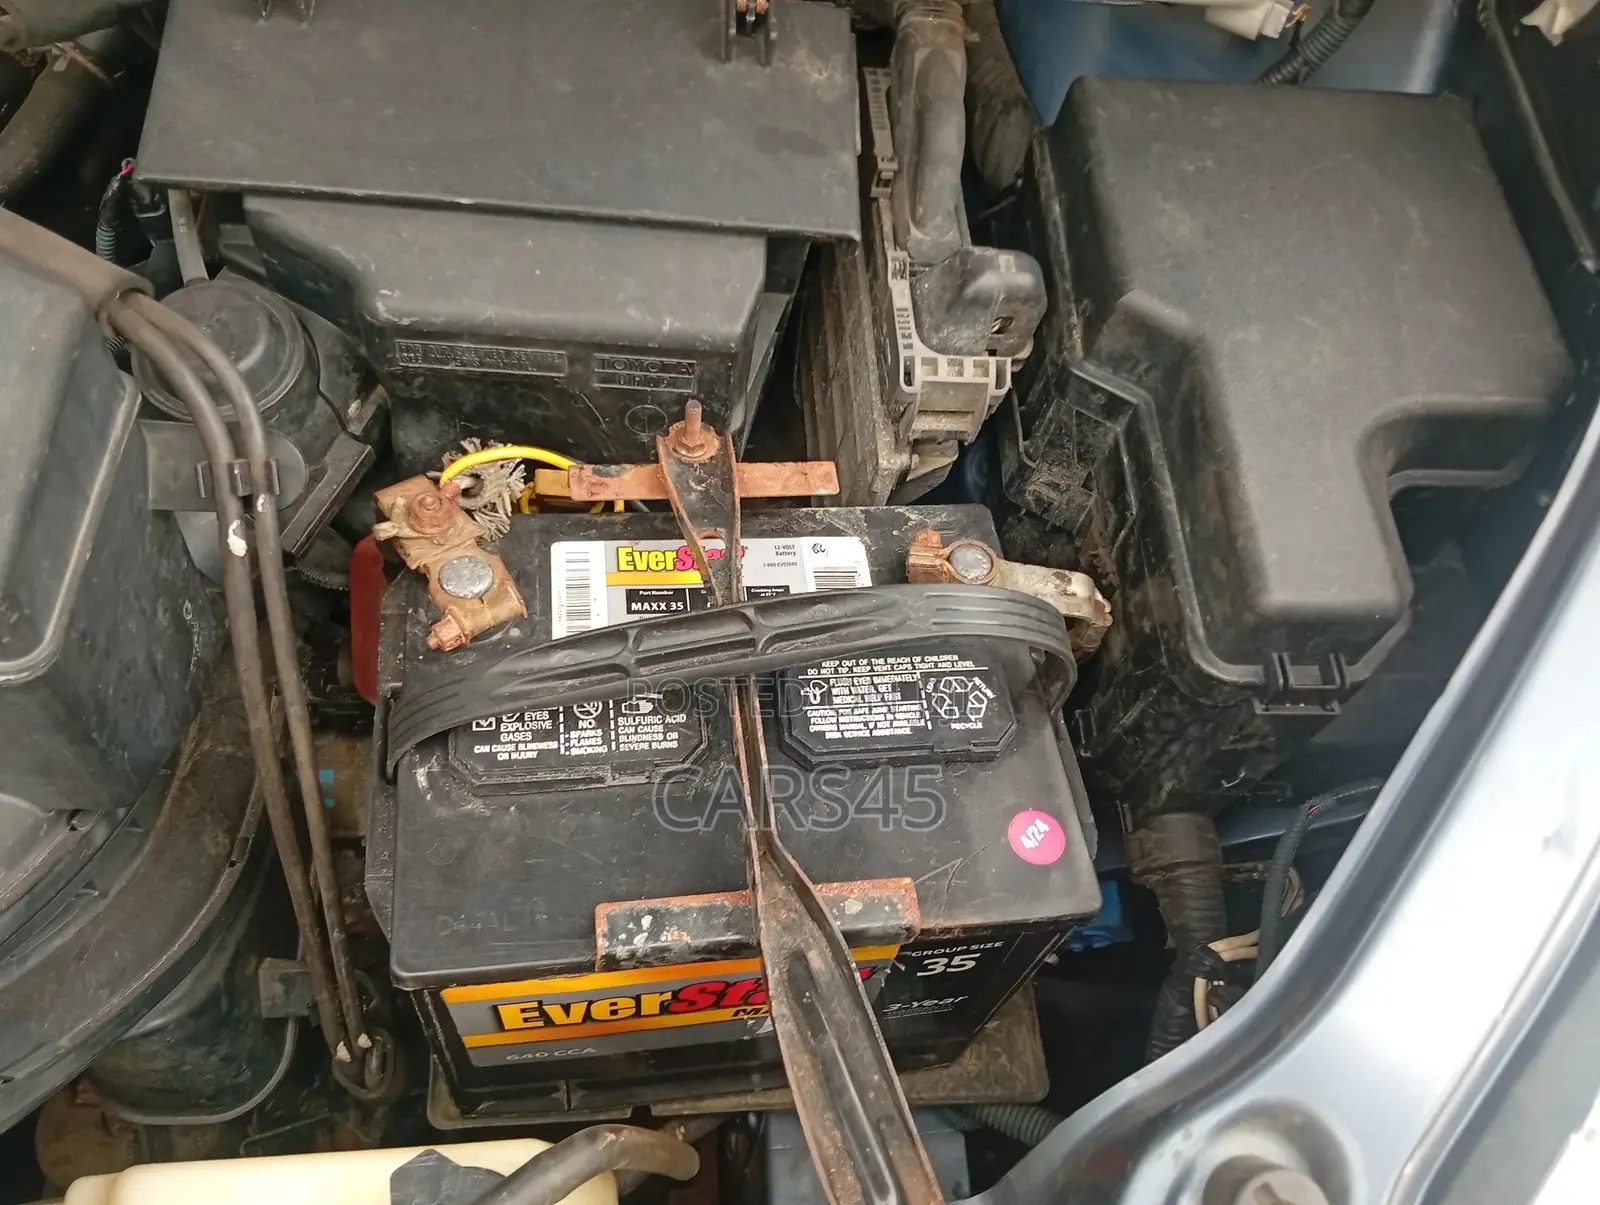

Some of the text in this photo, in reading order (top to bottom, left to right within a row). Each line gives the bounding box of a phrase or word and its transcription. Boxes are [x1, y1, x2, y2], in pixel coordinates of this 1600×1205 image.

[596, 357, 693, 375] TOYOTA
[616, 545, 745, 572] EverS
[631, 601, 684, 612] MAXX 35
[821, 660, 840, 668] KEEP
[841, 659, 857, 667] OUT
[887, 656, 911, 664] REACH
[911, 655, 923, 663] OF
[924, 654, 959, 663] CHILDREN
[807, 668, 819, 676] DO
[820, 667, 835, 675] NOT
[853, 665, 871, 673] KEEP
[873, 664, 892, 672] VENT
[893, 663, 913, 671] CAPS
[914, 662, 935, 670] TIGHT
[953, 660, 976, 668] LEVEL
[853, 676, 873, 685] EYES
[873, 673, 918, 684] IMMEDIATELY
[831, 686, 850, 695] WITH
[878, 684, 892, 693] GET
[524, 710, 550, 721] EYES
[617, 713, 687, 726] SULFURIC ACID
[500, 720, 553, 732] EXPLOSIVE
[578, 719, 596, 729] NO
[617, 724, 665, 735] CAN CAUSE
[950, 721, 984, 730] RECYCLE
[500, 731, 533, 742] GASES
[569, 729, 603, 739] SPARKS
[618, 731, 679, 743] BLINDNESS OR
[473, 741, 559, 754] CAN CAUSE BLINDNESS
[569, 737, 603, 747] FLAMES
[619, 740, 679, 751] SEVERE BURNS
[496, 751, 539, 761] OR INJURY
[570, 745, 609, 756] SMOKING
[911, 940, 1005, 957] GROUP SIZE
[916, 952, 982, 978] 35
[494, 966, 874, 1031] EverSt
[882, 995, 970, 1012] 3-Year
[505, 1047, 597, 1061] 640 CCA
